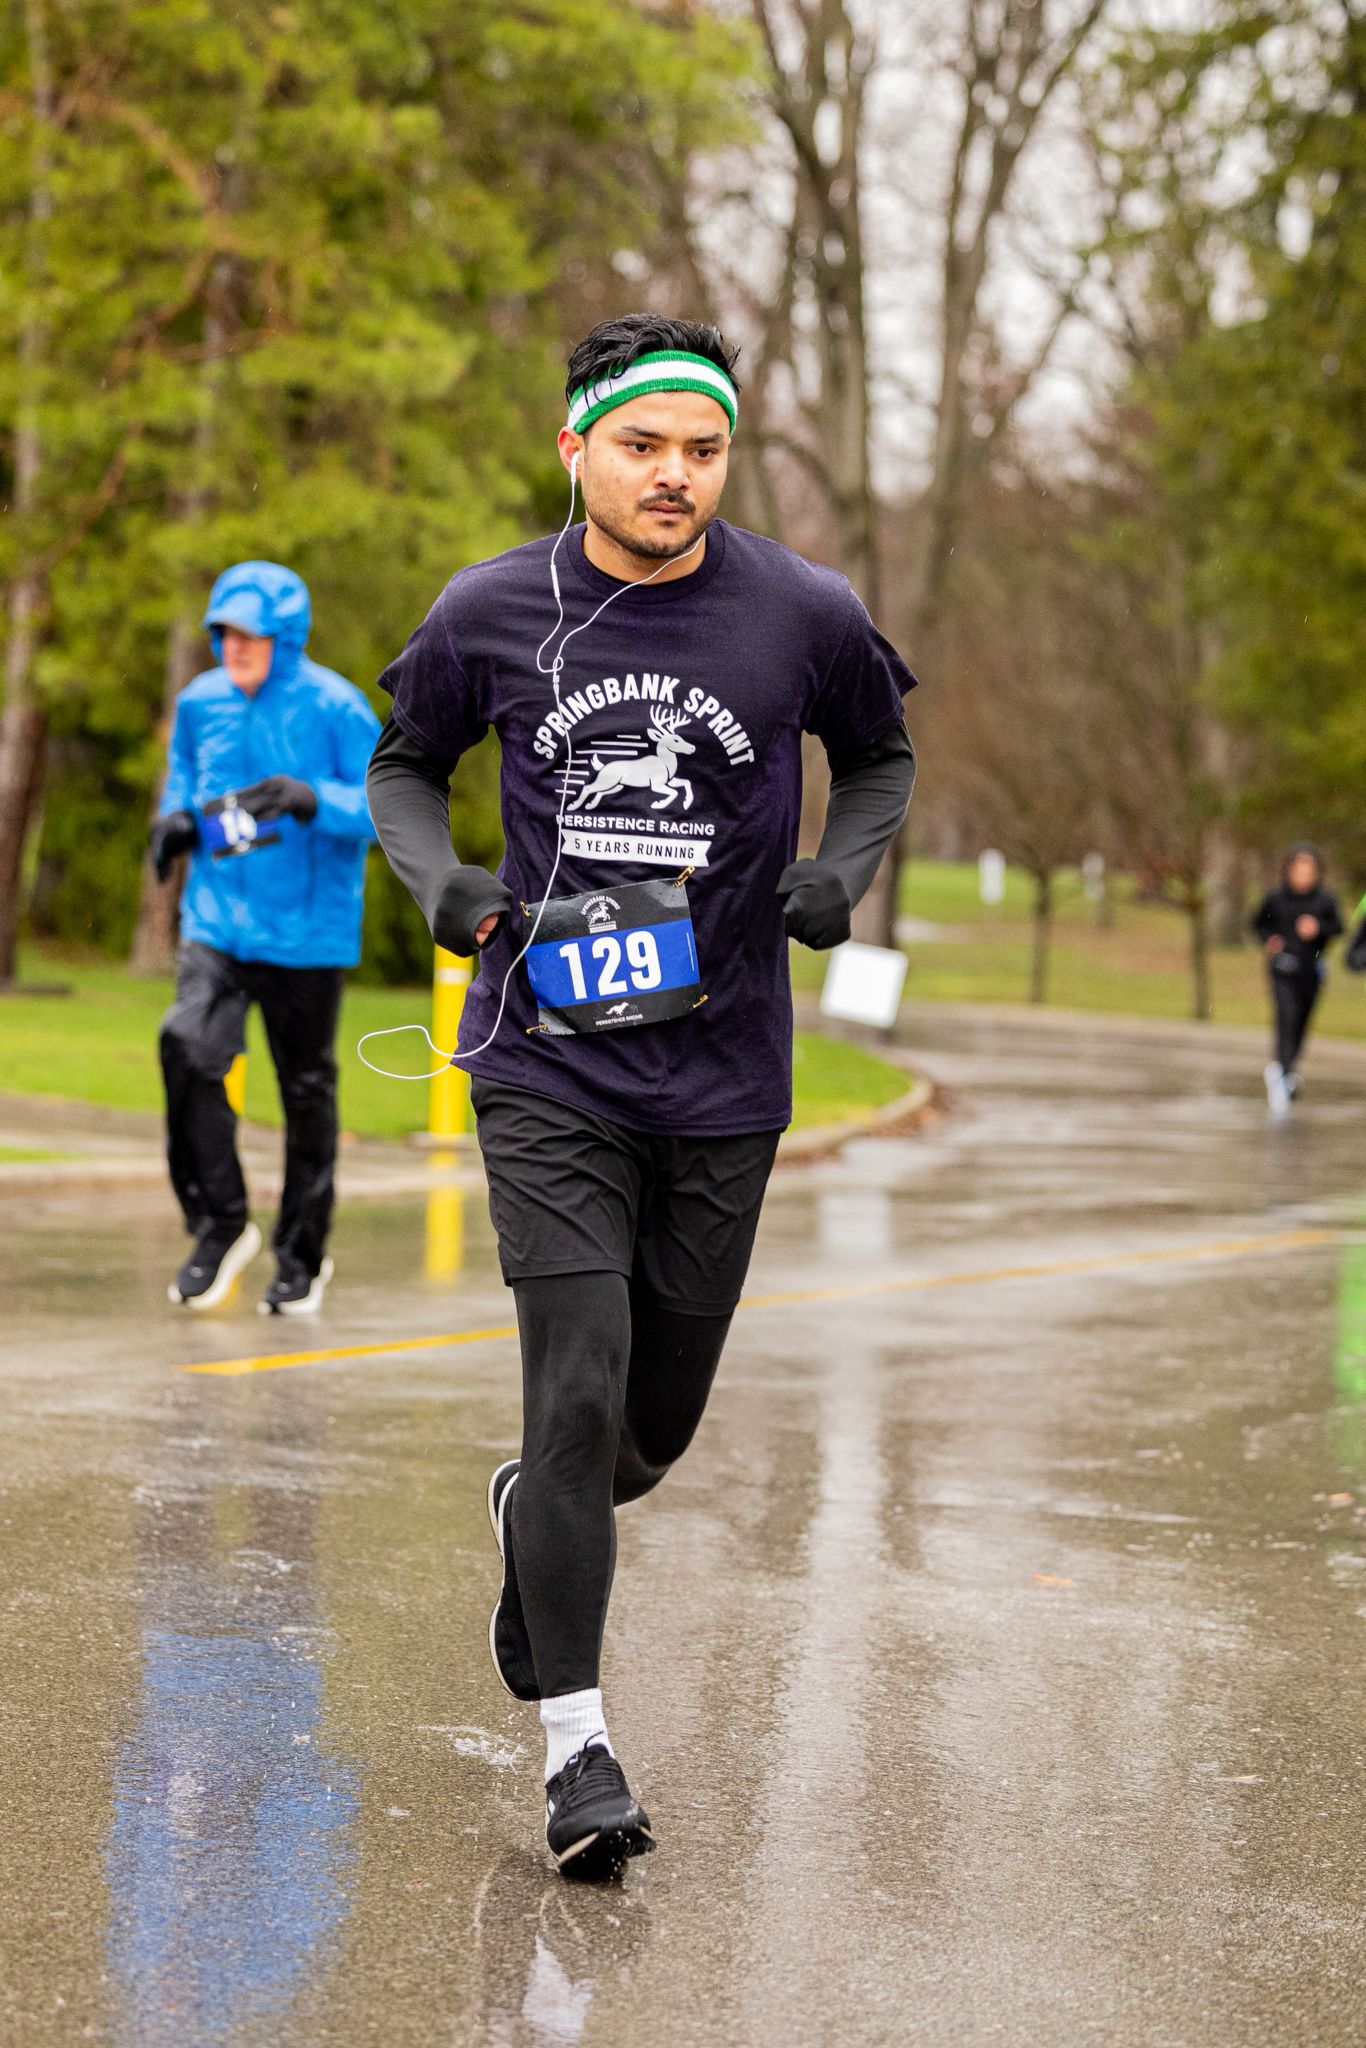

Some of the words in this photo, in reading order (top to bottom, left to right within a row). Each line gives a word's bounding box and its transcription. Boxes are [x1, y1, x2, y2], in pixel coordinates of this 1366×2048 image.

[533, 673, 680, 759] SPRINGBANK
[683, 687, 755, 766] SPRINT
[555, 814, 655, 832] PERSISTENCE
[659, 821, 715, 836] RACING
[574, 838, 581, 850] 5
[586, 839, 630, 854] YEARS
[637, 843, 695, 859] RUNNING
[559, 930, 662, 1000] 129
